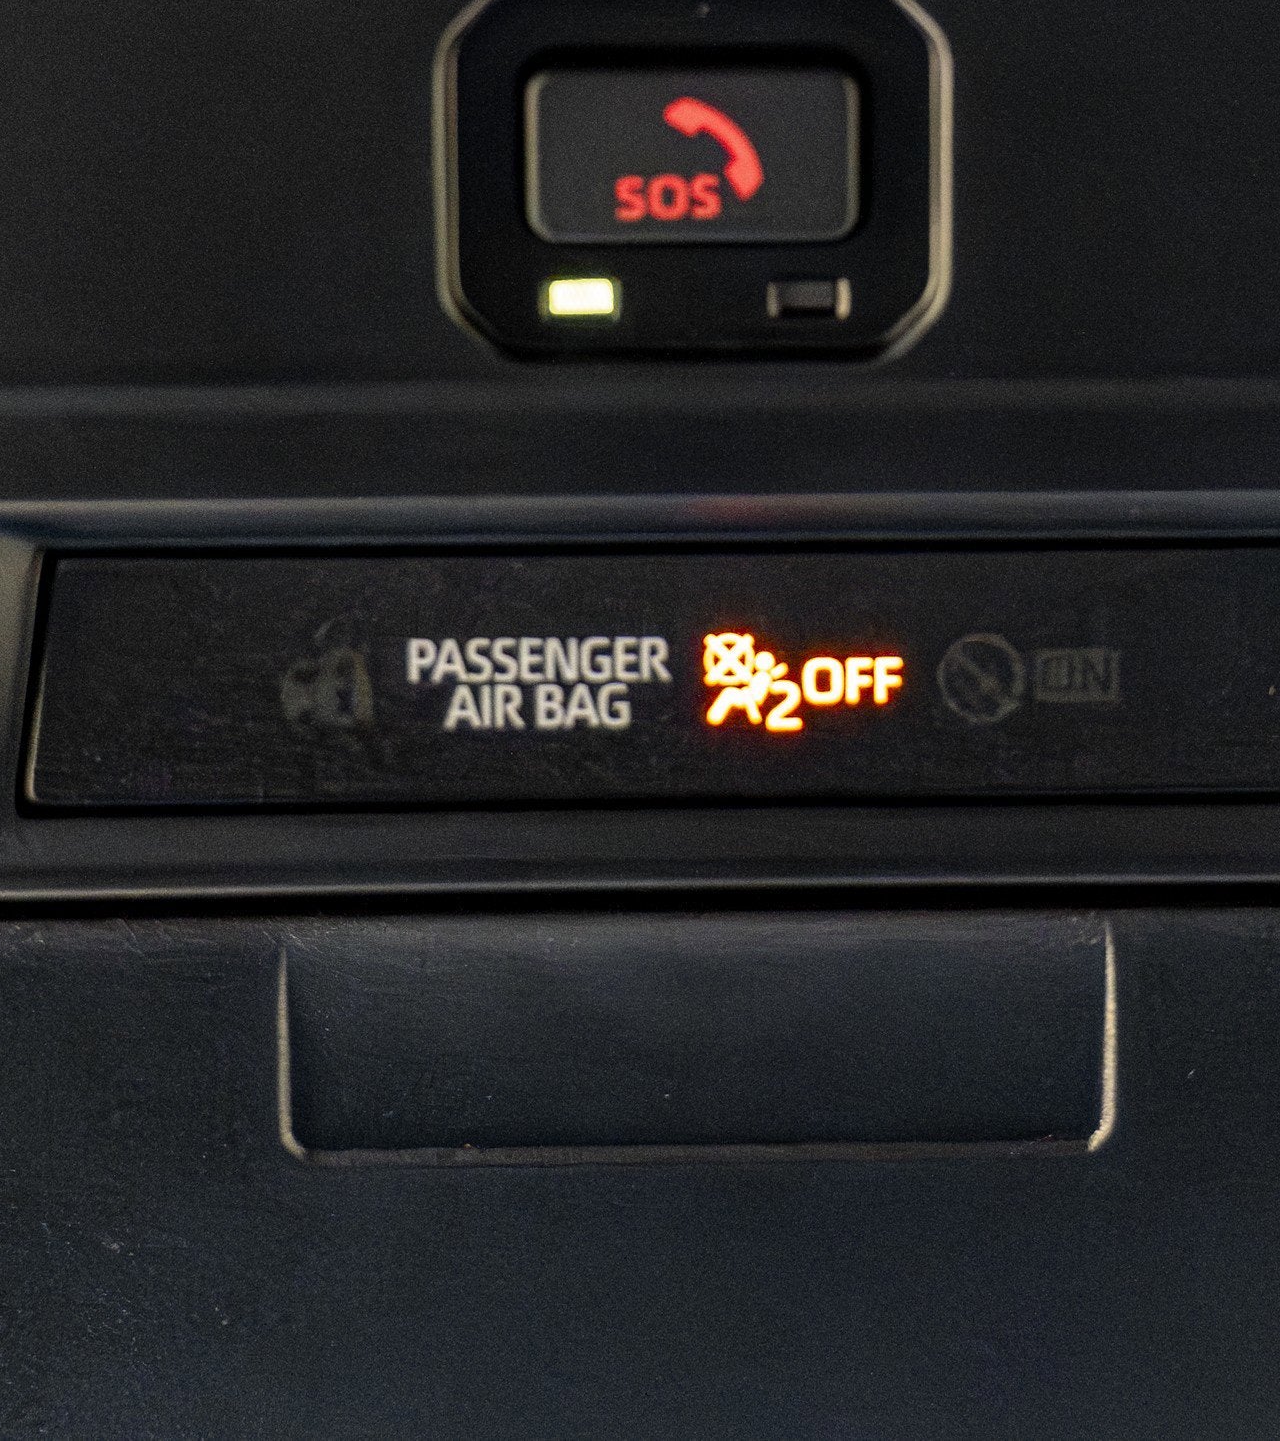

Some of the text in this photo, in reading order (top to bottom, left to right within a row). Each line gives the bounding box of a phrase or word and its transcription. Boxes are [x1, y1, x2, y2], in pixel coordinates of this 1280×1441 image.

[614, 174, 722, 222] SOS
[405, 636, 672, 684] PASSENGER
[801, 655, 904, 705] OFF
[442, 682, 632, 730] AIR BAG
